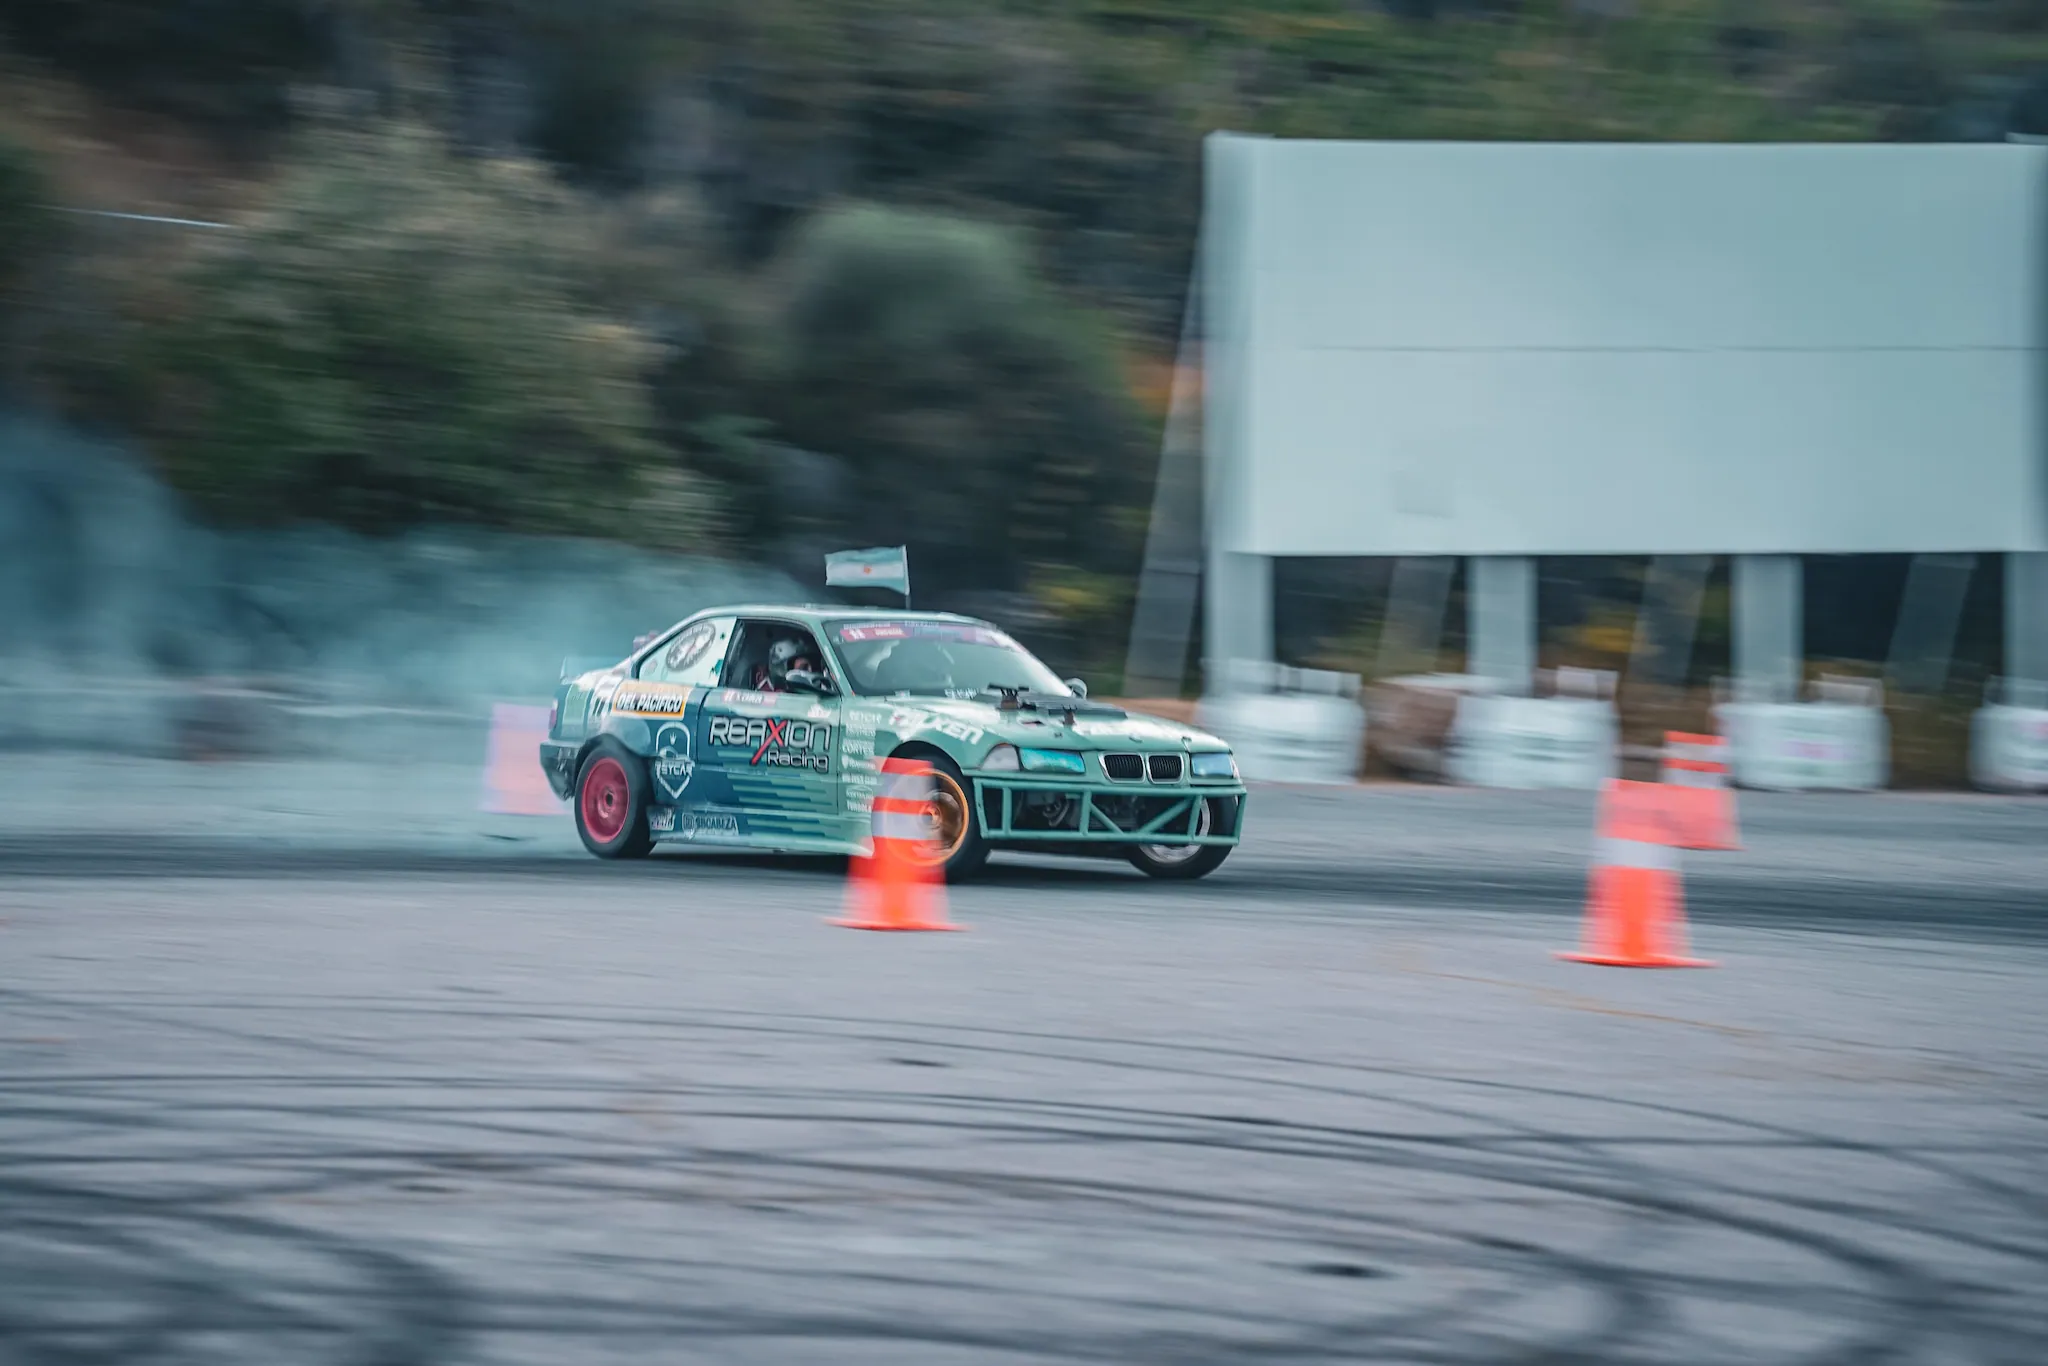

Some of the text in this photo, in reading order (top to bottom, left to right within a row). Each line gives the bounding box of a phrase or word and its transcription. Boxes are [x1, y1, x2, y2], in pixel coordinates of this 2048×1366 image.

[617, 692, 637, 711] DEL
[637, 693, 683, 713] PACIFICO
[768, 749, 830, 774] Racing
